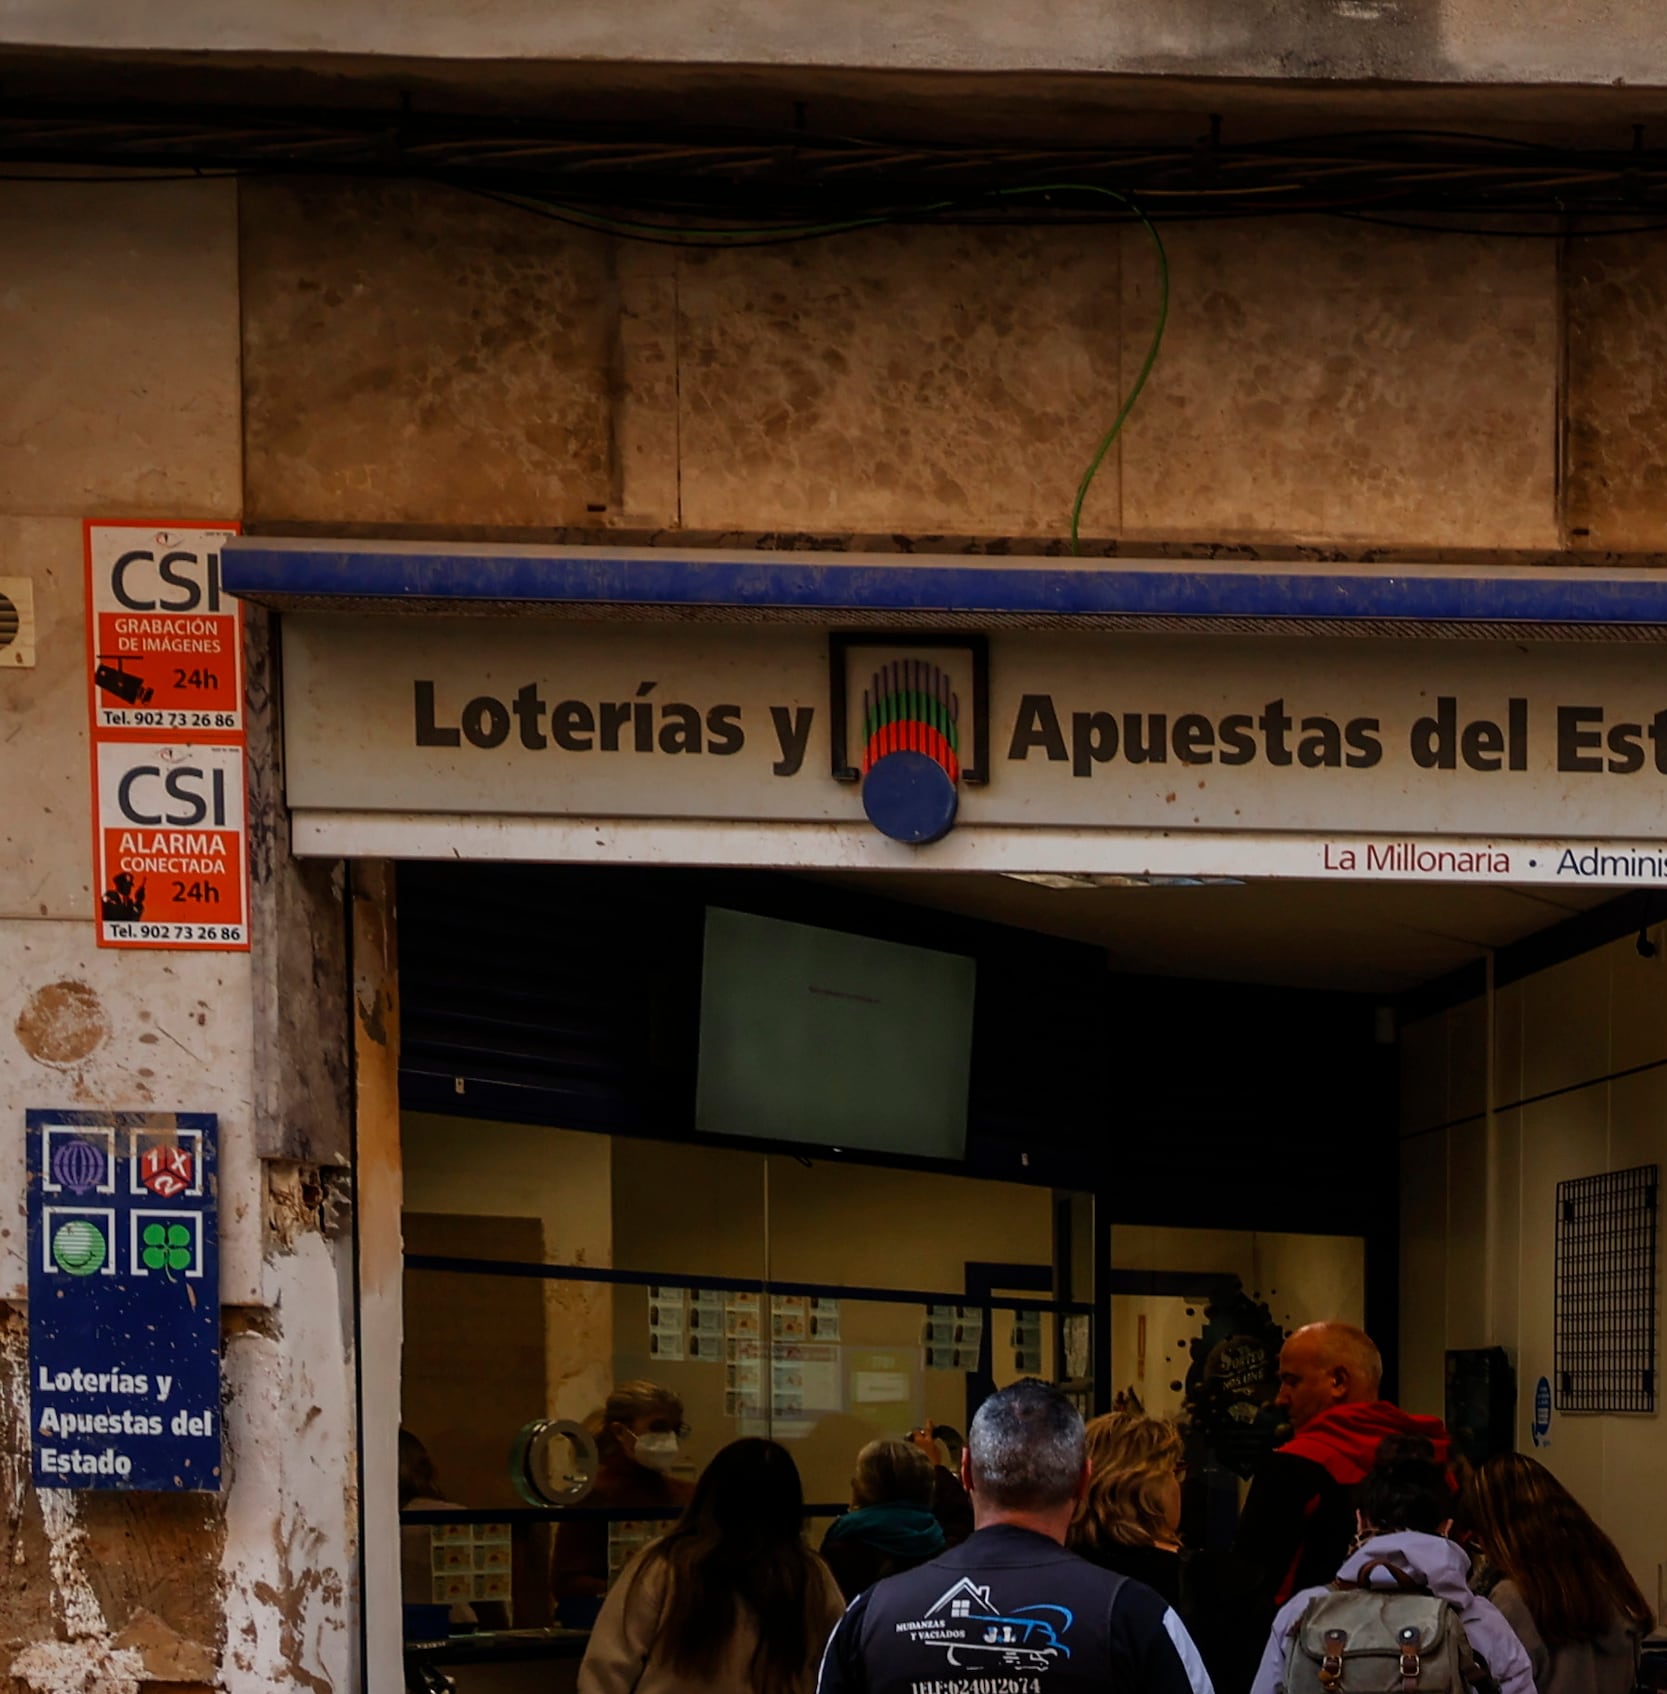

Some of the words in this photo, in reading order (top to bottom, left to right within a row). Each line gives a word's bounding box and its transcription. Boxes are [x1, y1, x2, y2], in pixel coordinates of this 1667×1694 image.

[111, 551, 220, 612] CSI
[114, 616, 218, 637] GRABACIÓN
[118, 636, 139, 652] DE
[142, 635, 222, 653] IMÁGENES
[172, 668, 219, 690] 24h
[104, 711, 131, 726] Tel.
[134, 711, 163, 727] 902
[166, 711, 188, 727] 73
[191, 711, 211, 727] 26
[215, 711, 235, 728] 86
[414, 680, 745, 756] Loterías
[769, 706, 815, 777] y
[1007, 694, 1384, 778] Apuestas
[1409, 696, 1528, 771] del
[117, 765, 226, 827] CSI
[119, 832, 227, 856] ALARMA
[120, 857, 226, 875] CONECTADA
[1323, 843, 1357, 872] La
[1366, 842, 1511, 875] Millonaria
[172, 880, 220, 903] 24h
[110, 923, 138, 940] Tel.
[141, 924, 170, 940] 902
[173, 925, 194, 940] 73
[199, 925, 218, 940] 26
[221, 926, 241, 941] 86
[39, 1366, 149, 1394] Loterías
[157, 1375, 173, 1401] y
[40, 1407, 163, 1438] Apuestas
[171, 1410, 213, 1437] del
[40, 1449, 132, 1476] Estado
[896, 1619, 946, 1632] MUDANZAS
[910, 1632, 917, 1641] Y
[918, 1629, 966, 1640] VACIADOS
